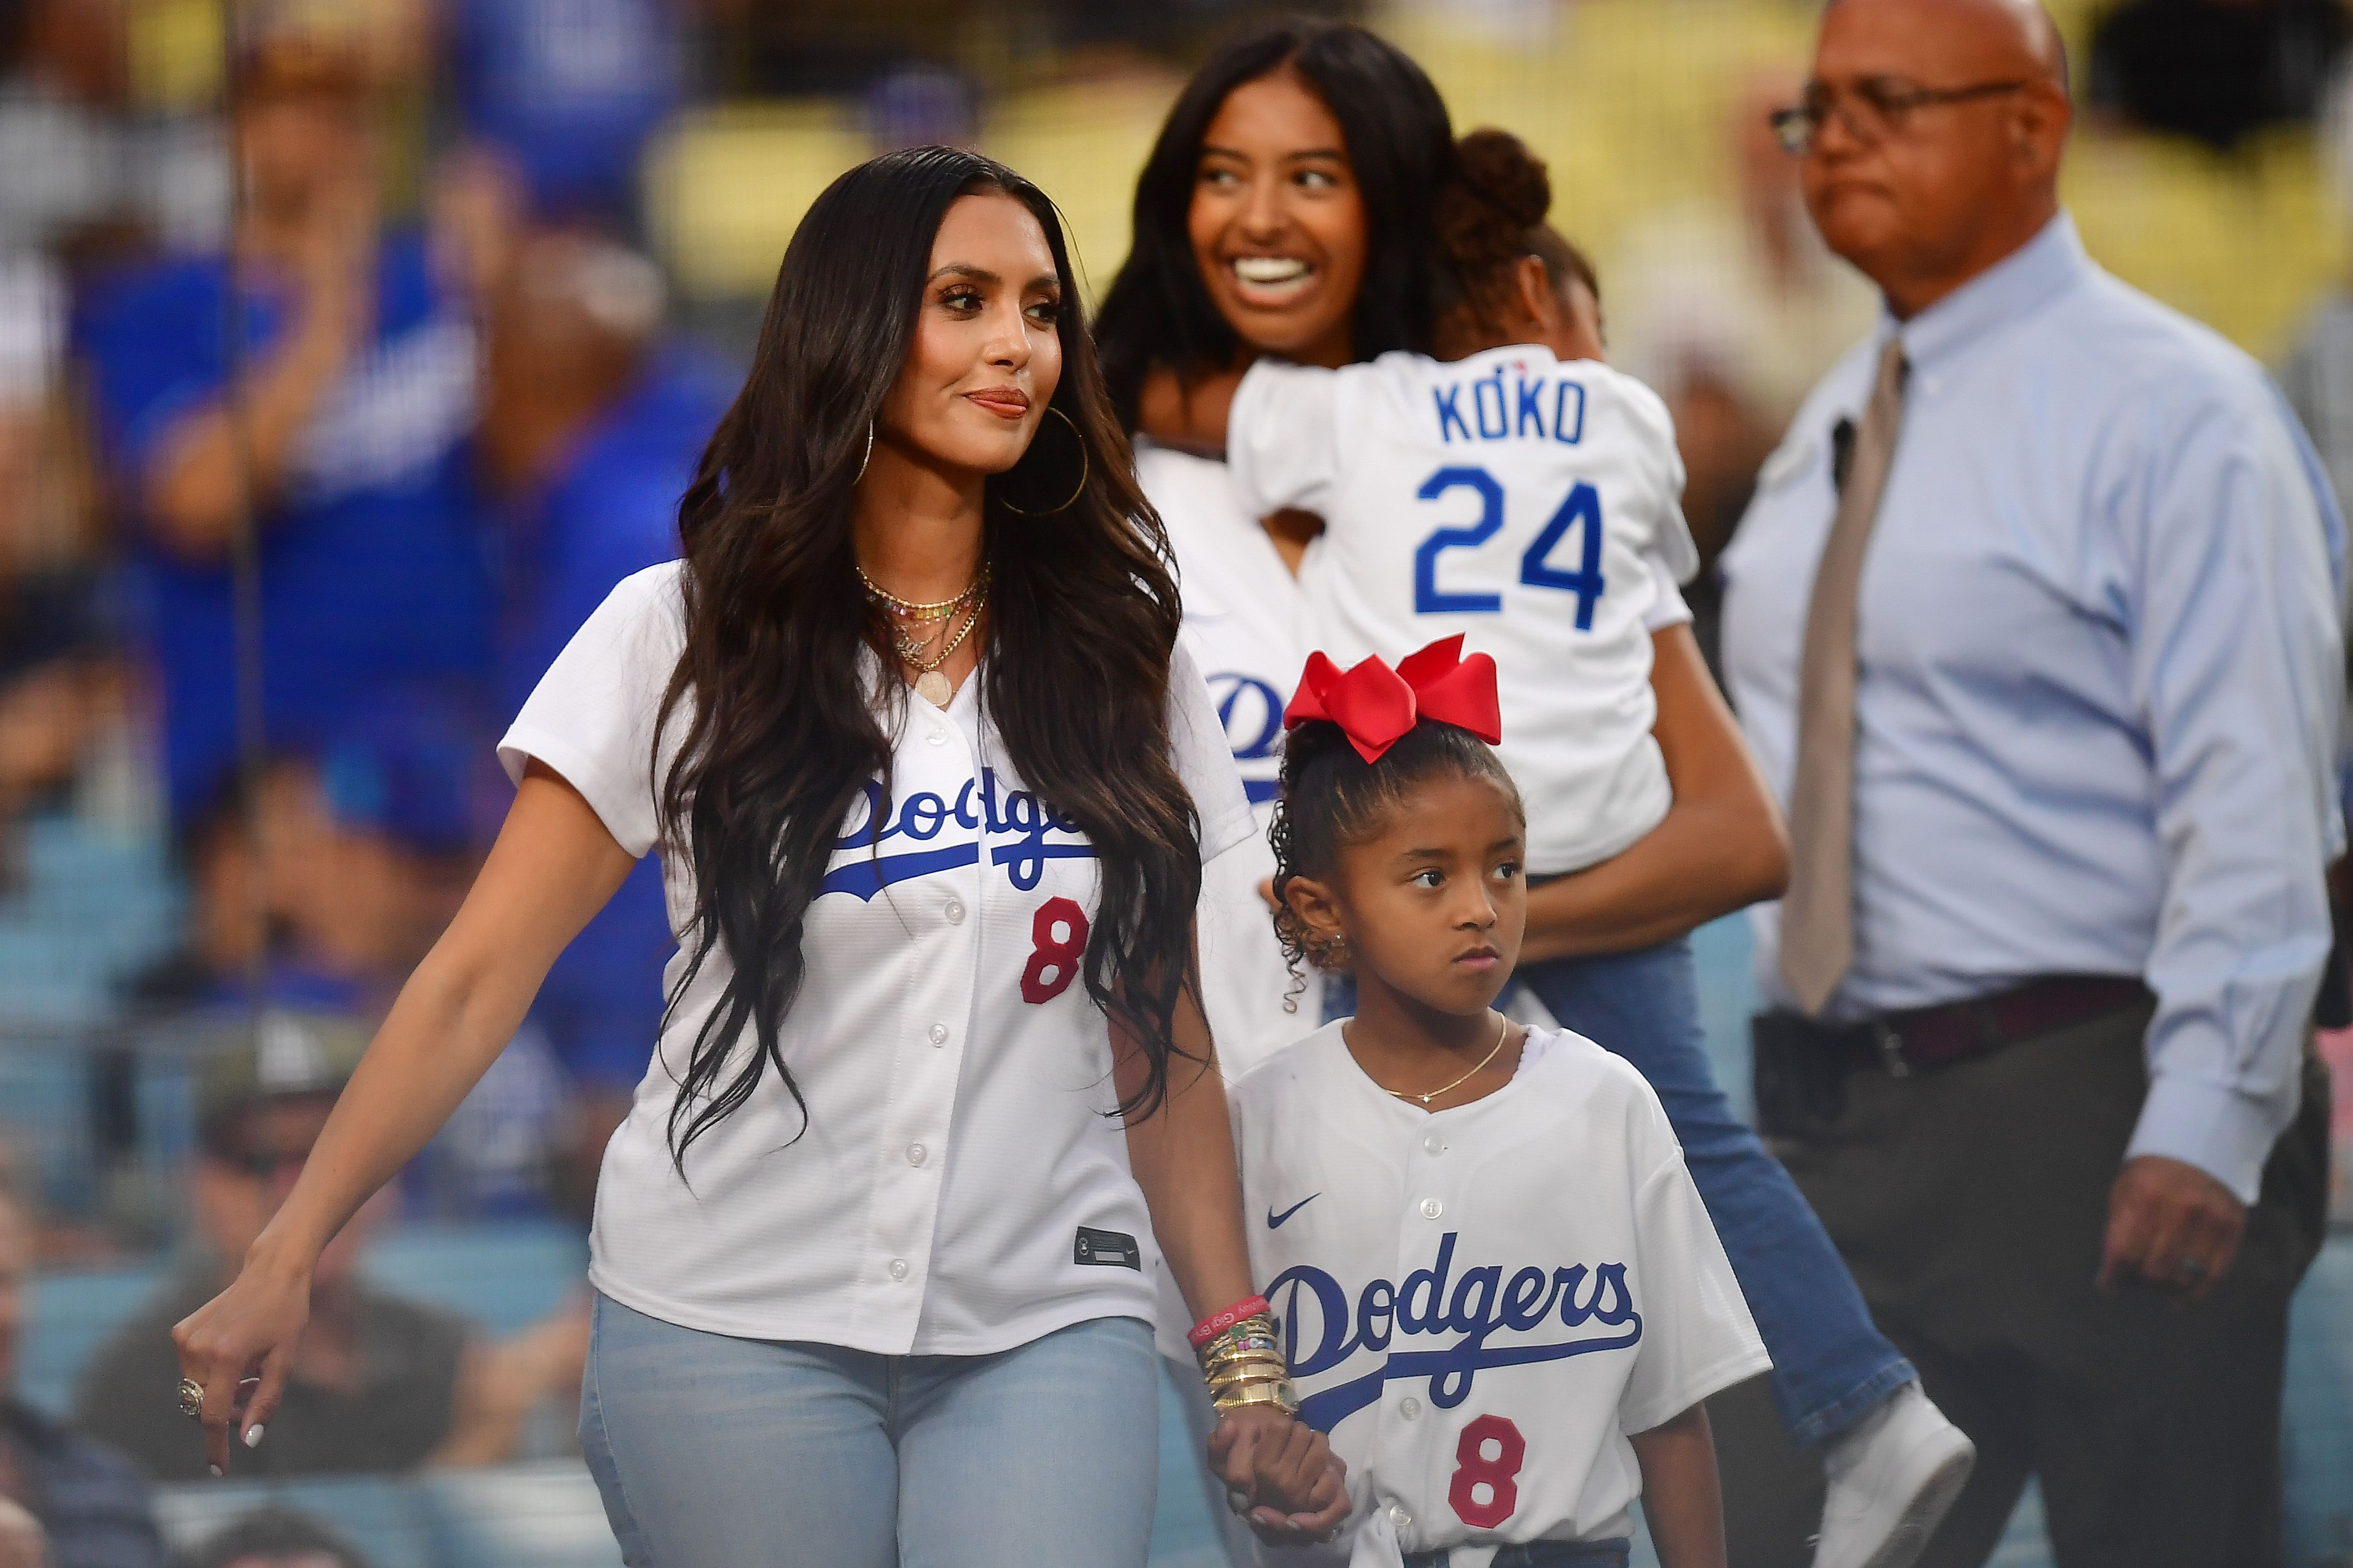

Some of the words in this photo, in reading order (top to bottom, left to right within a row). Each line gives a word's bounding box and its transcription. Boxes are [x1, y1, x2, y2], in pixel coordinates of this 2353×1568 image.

[1434, 378, 1585, 445] KOKO
[1414, 466, 1605, 631] 24
[826, 767, 1086, 891] Dodg
[1020, 896, 1089, 1004] 8
[1264, 1231, 1642, 1409] Dodgers
[1448, 1413, 1526, 1529] 8
